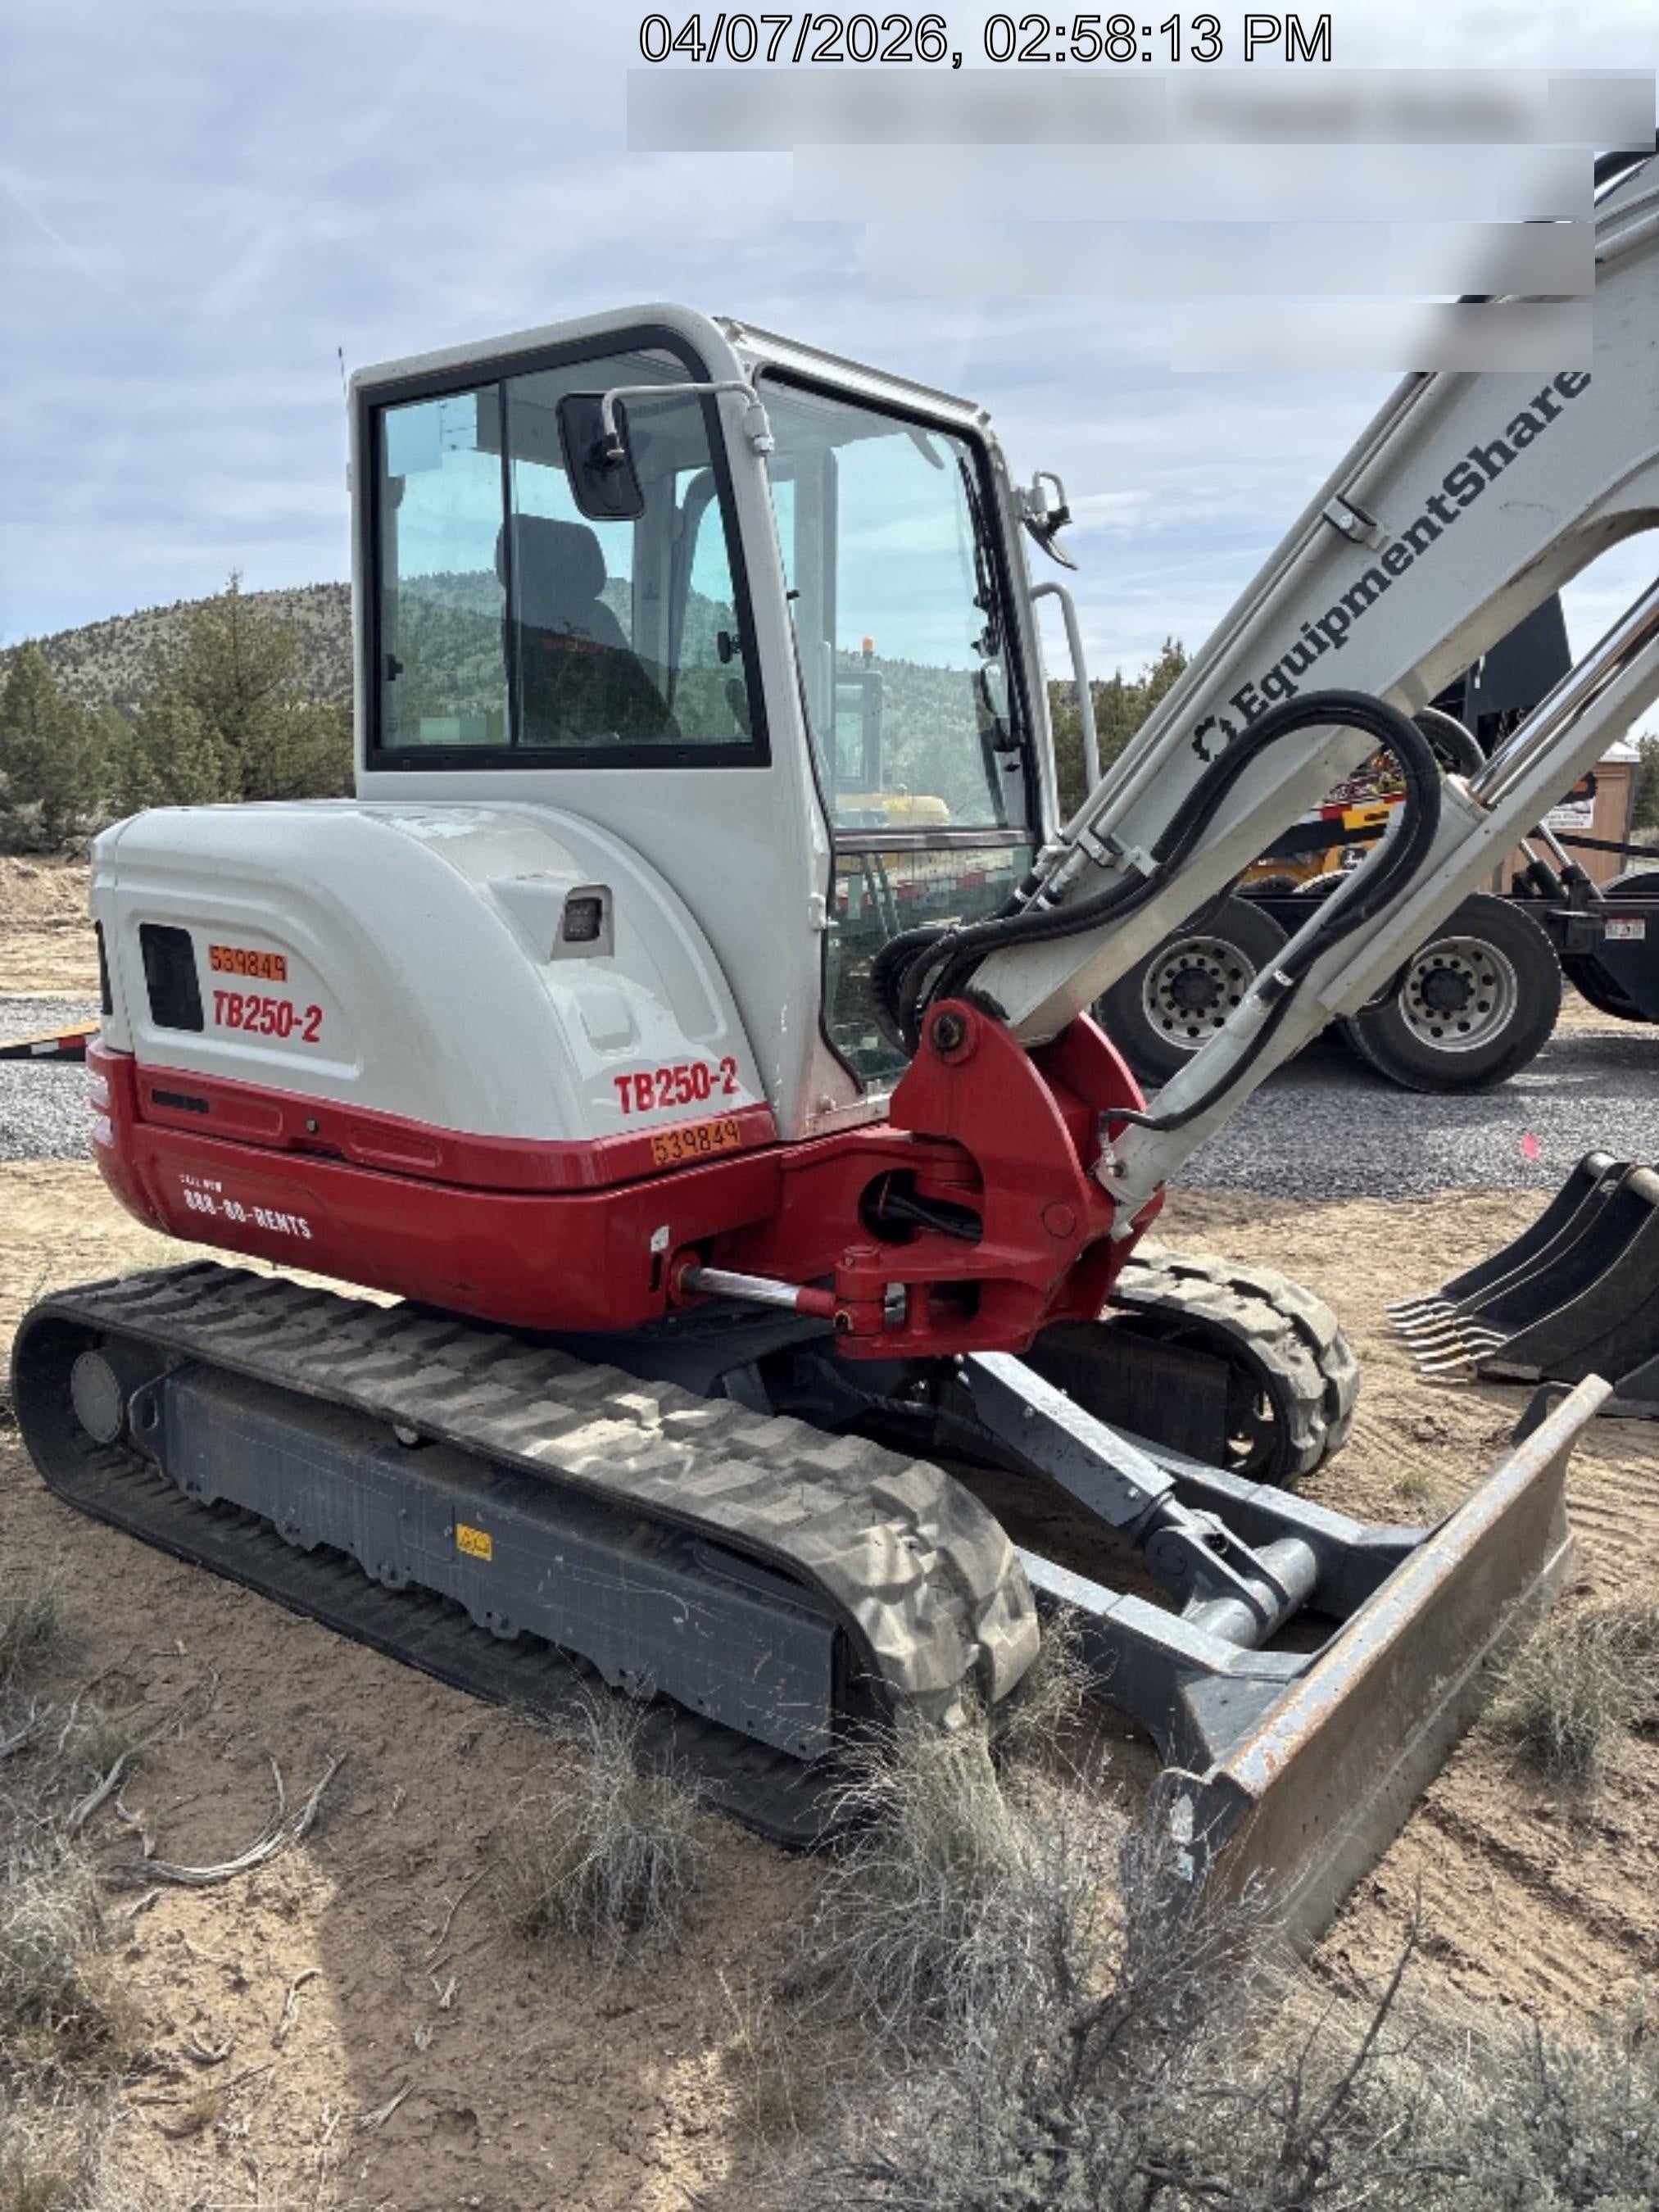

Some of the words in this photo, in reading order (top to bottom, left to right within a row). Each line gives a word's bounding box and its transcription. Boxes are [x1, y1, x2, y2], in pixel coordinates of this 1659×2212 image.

[1229, 372, 1592, 726] EquipmentShare
[210, 945, 287, 982] 539849
[213, 990, 323, 1043] TB250-2
[614, 1056, 740, 1114] TB250-2
[654, 1119, 739, 1163] 539849
[183, 1189, 312, 1240] 888-80-RENTS
